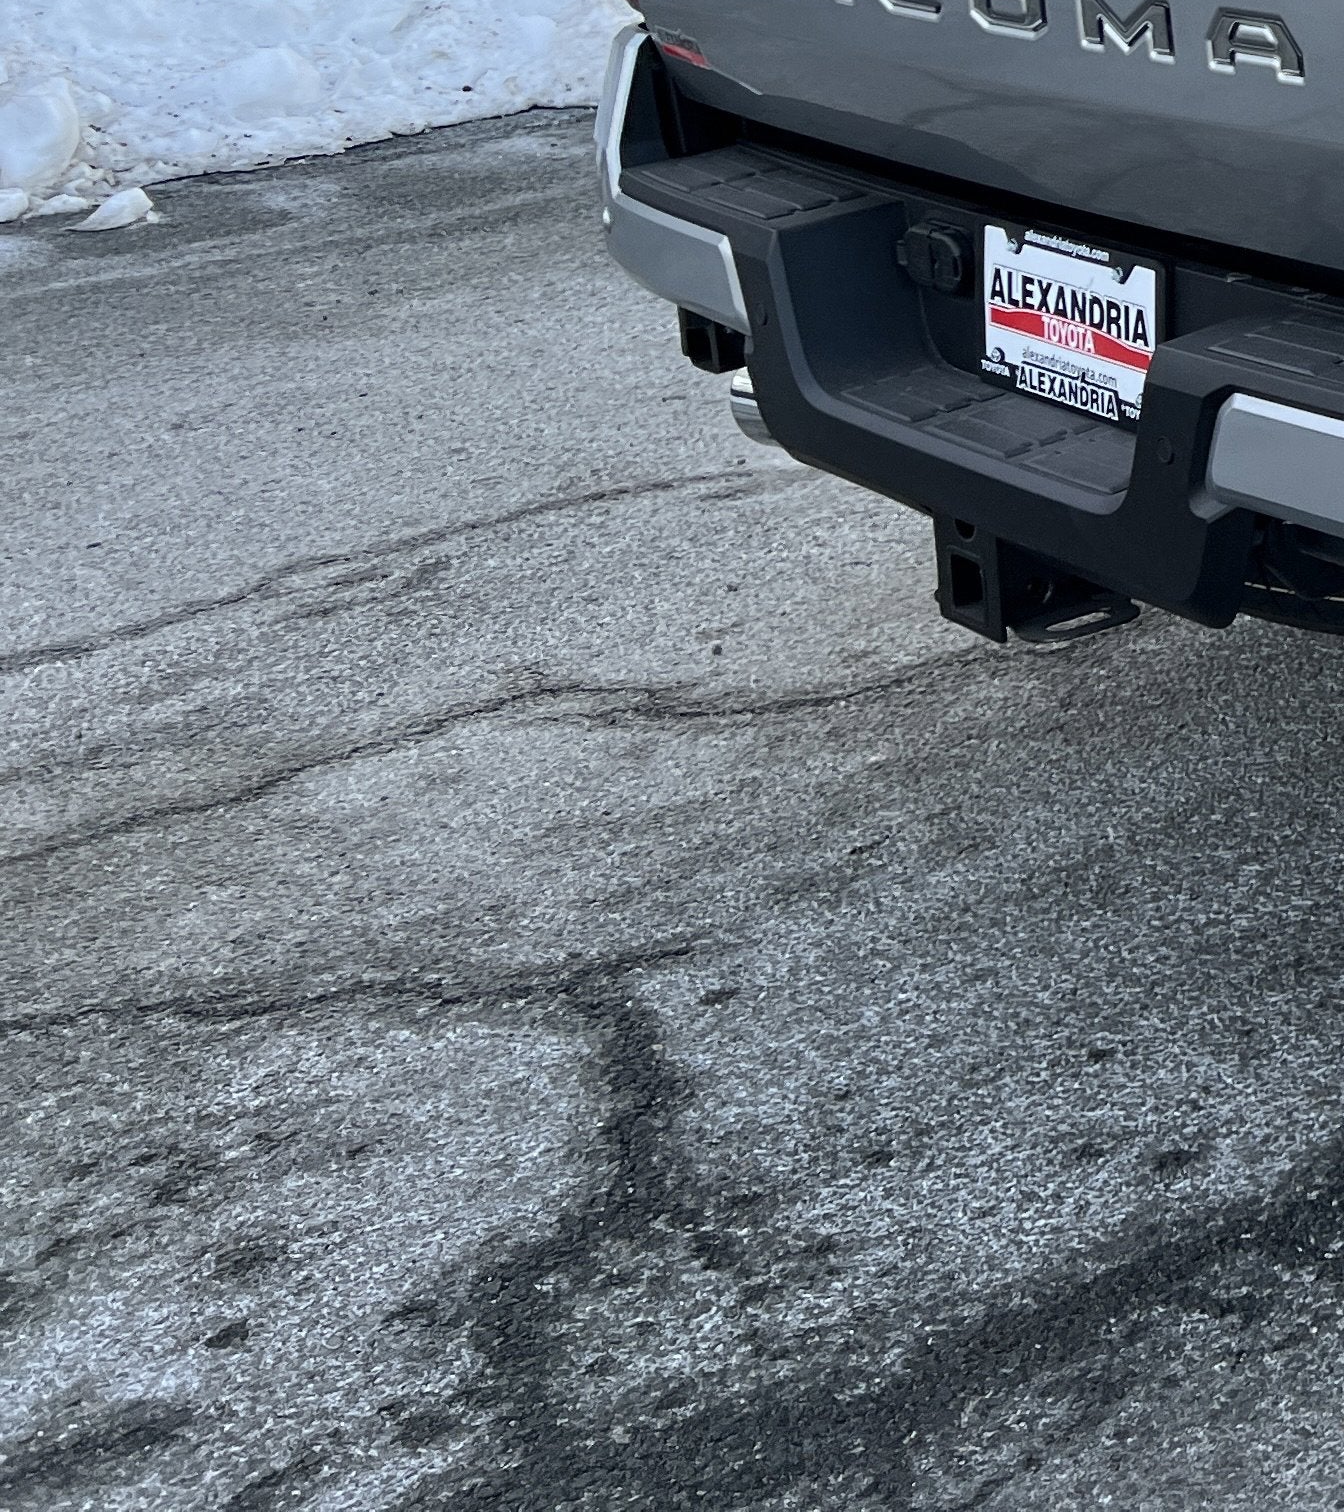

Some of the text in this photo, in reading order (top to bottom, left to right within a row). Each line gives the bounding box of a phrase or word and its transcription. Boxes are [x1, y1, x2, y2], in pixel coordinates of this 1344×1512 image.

[991, 267, 1150, 348] ALEXANDRIA
[1041, 316, 1096, 354] TOYOTA
[1018, 365, 1118, 419] ALEXANDRIA
